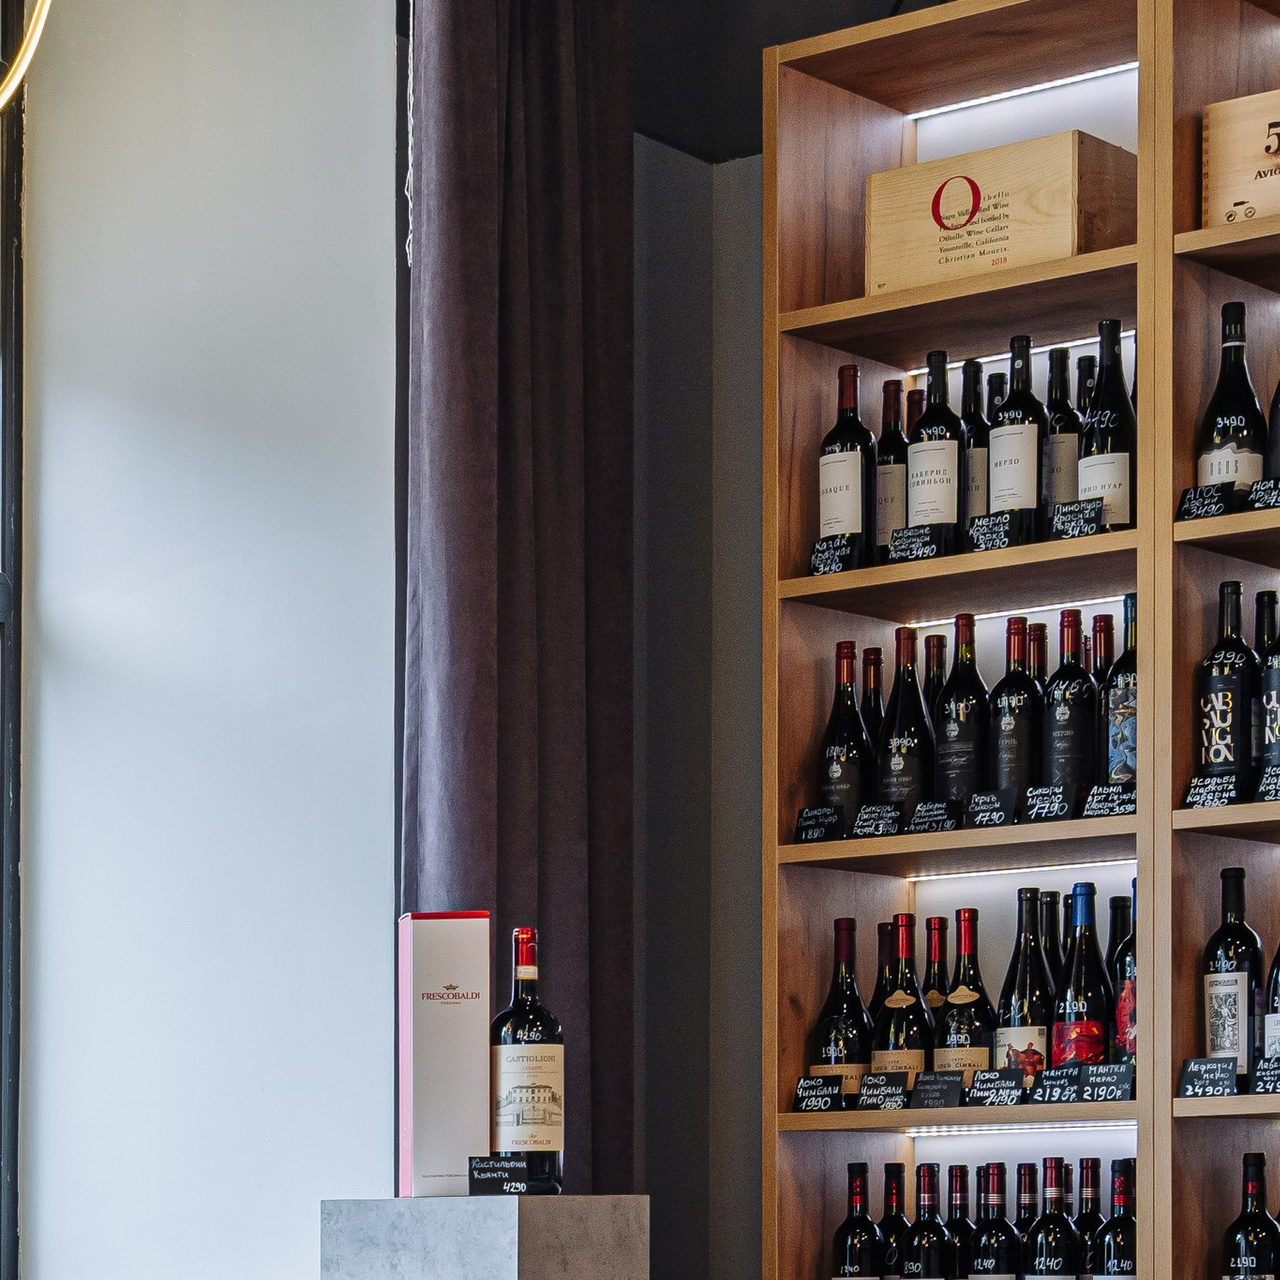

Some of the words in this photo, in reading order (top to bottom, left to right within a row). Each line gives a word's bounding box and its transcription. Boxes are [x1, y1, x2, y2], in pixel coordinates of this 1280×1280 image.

[966, 229, 984, 238] Wine
[939, 253, 976, 265] Christian
[991, 256, 1008, 267] 2018
[1216, 415, 1246, 428] 3490
[920, 425, 946, 438] 3490
[994, 458, 1020, 468] МЕРЛО
[1185, 503, 1224, 519] 3490
[1061, 523, 1097, 539] 3490
[973, 537, 1009, 552] 3490
[908, 544, 938, 559] 3490
[813, 562, 843, 576] 3490
[1028, 803, 1069, 820] 1790
[974, 812, 1005, 826] 1790
[801, 828, 825, 840] 1890
[421, 992, 481, 1001] FRESCOBALDI
[506, 1055, 556, 1063] CASTIGLIONI
[799, 1097, 831, 1110] 1990
[982, 1094, 1018, 1106] 1490
[502, 1182, 527, 1193] 4290
[903, 1261, 922, 1274] 890
[974, 1258, 996, 1270] 1240
[1034, 1256, 1063, 1270] 1240
[1230, 1256, 1257, 1268] 2190
